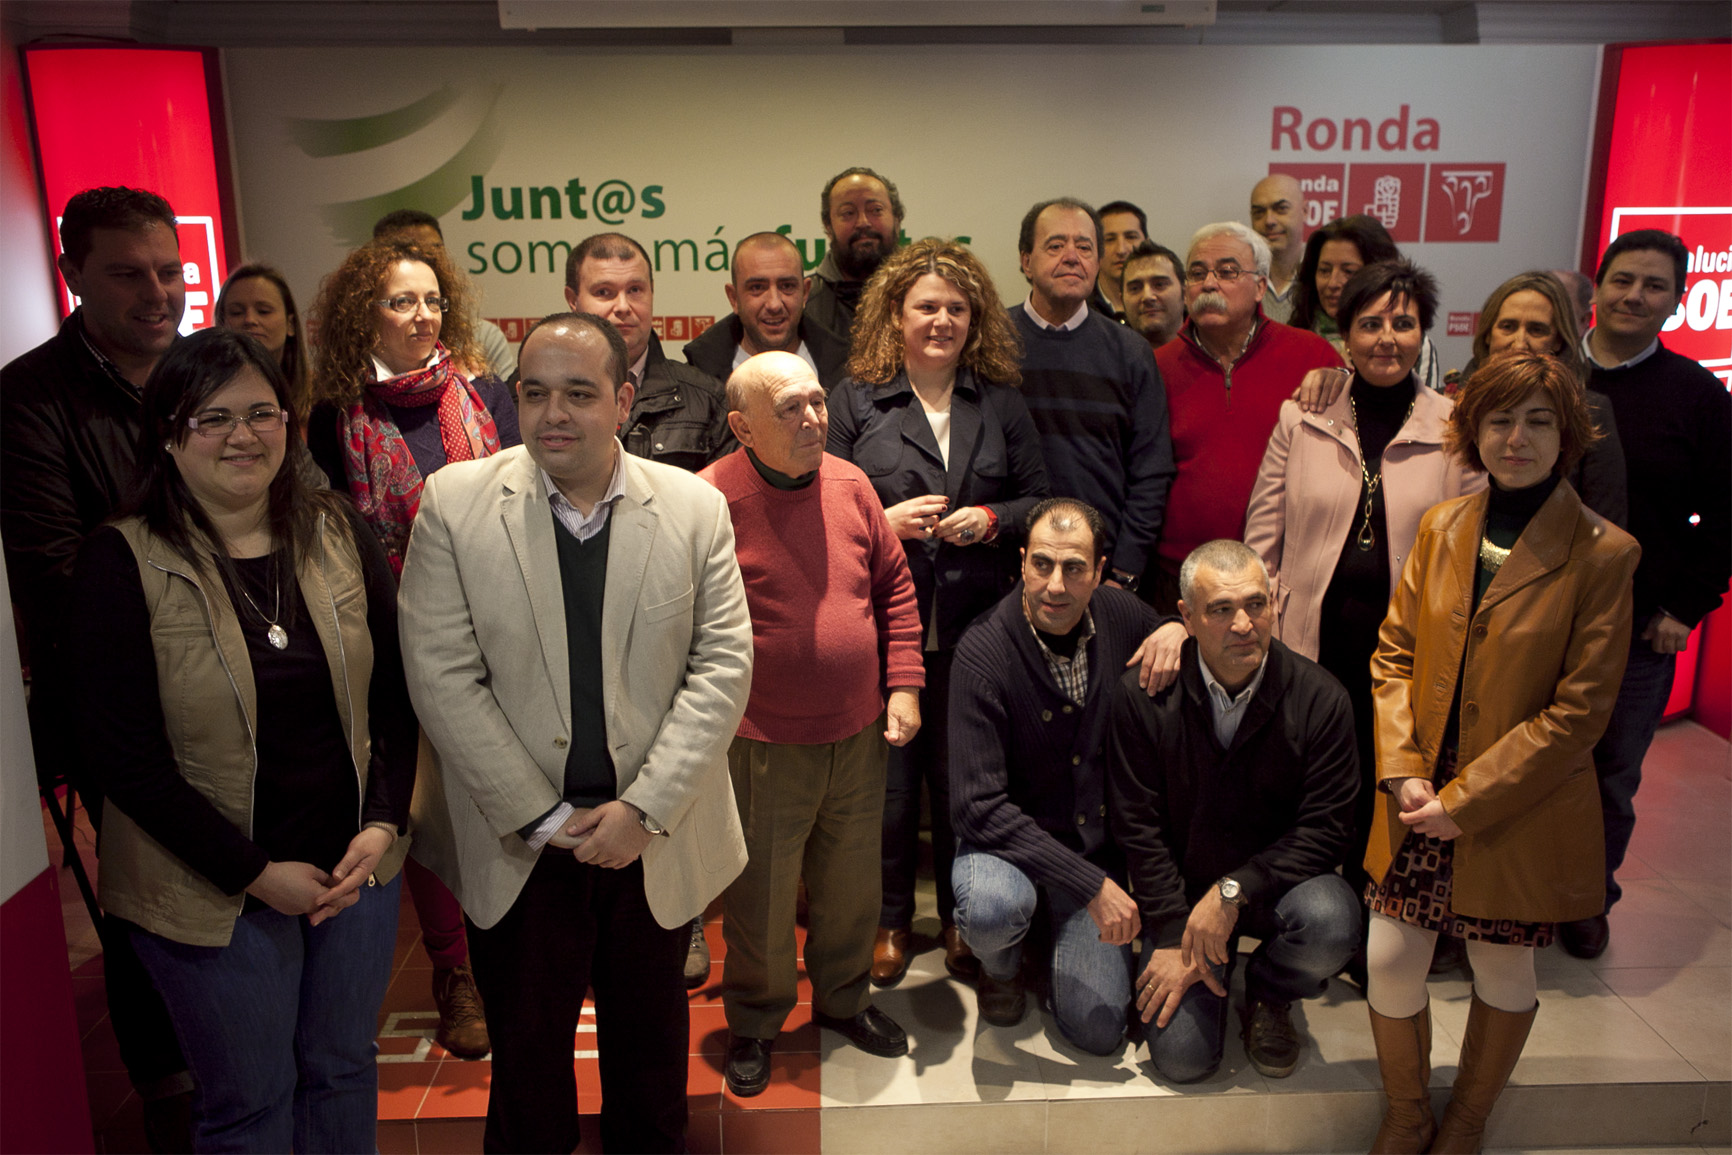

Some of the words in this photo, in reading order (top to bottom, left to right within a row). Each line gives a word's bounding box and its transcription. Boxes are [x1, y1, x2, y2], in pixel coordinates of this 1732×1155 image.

[1271, 104, 1440, 151] Ronda
[462, 175, 666, 225] Junt@s
[1301, 175, 1339, 193] nda
[1305, 200, 1339, 226] OE
[467, 240, 572, 275] som
[654, 225, 740, 272] má
